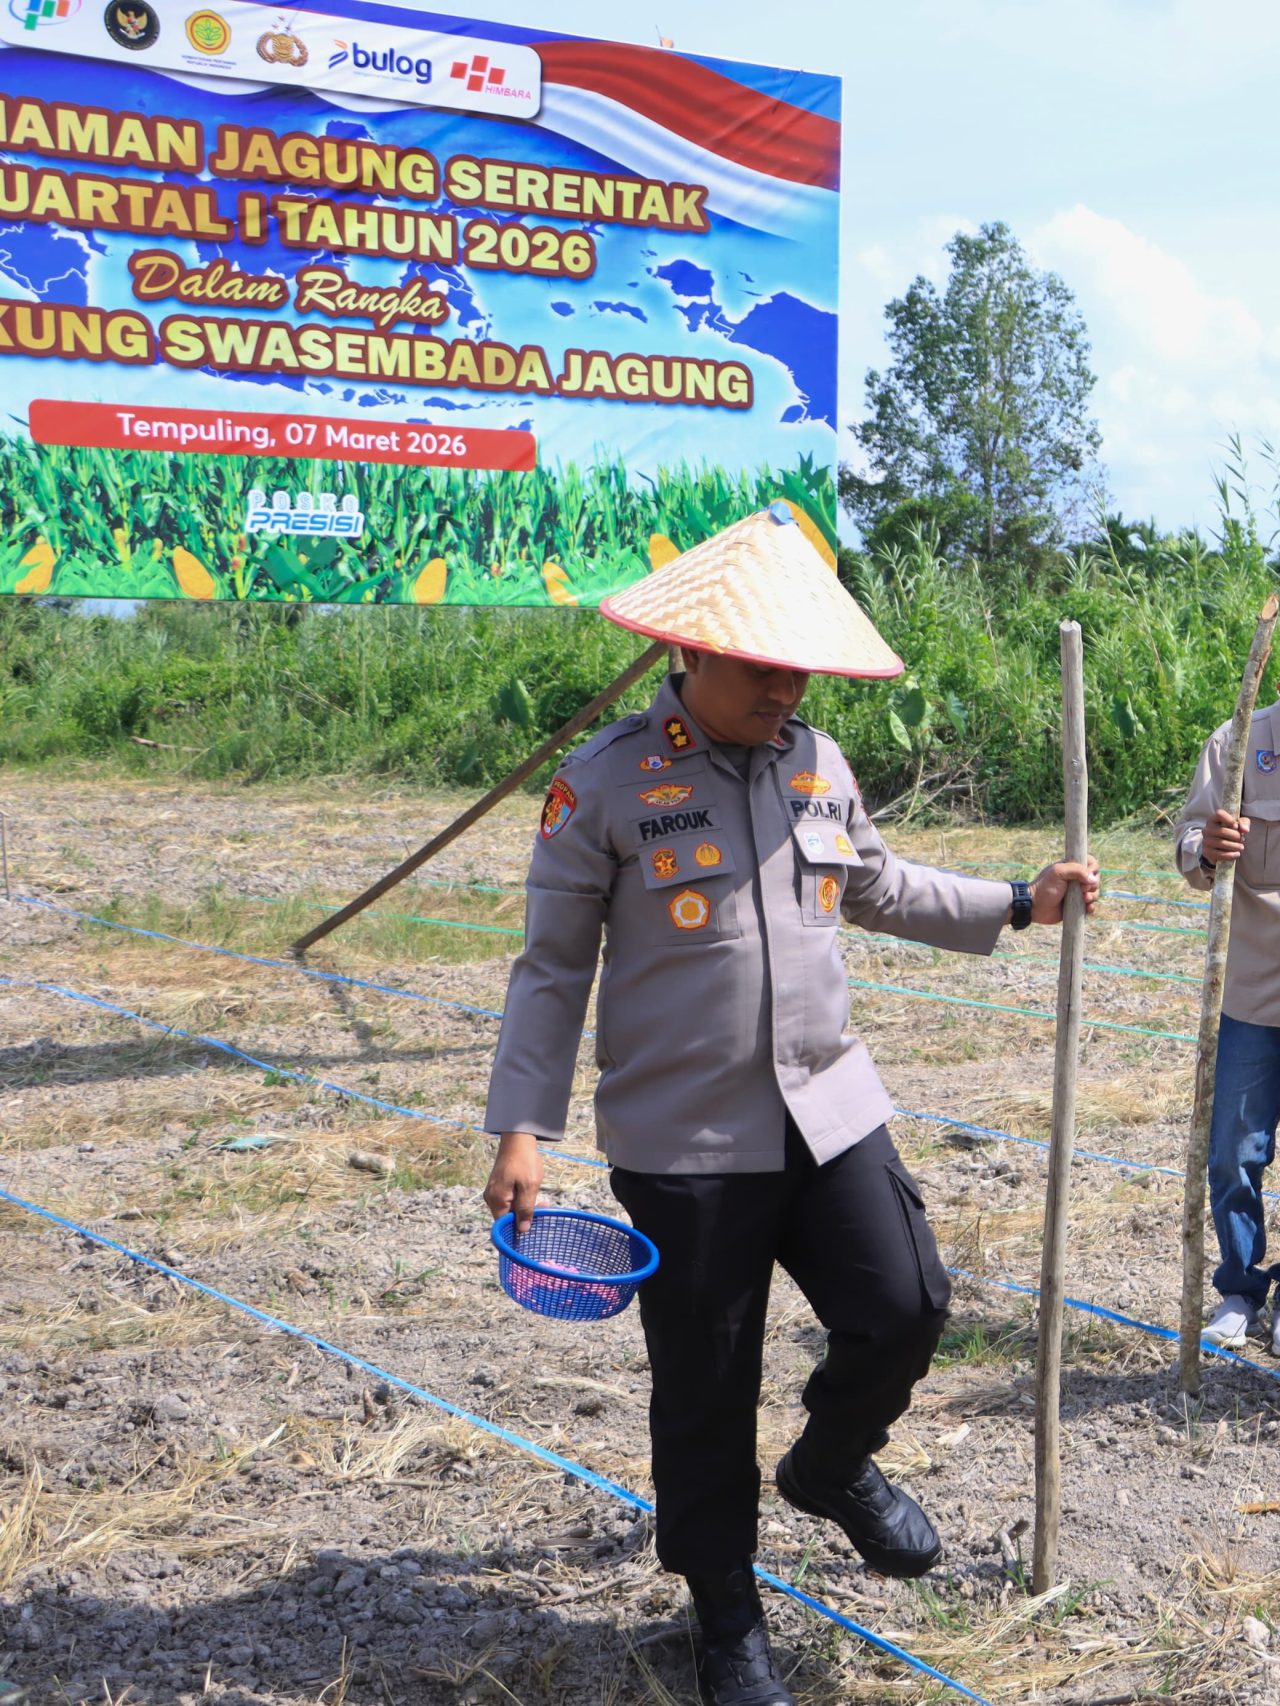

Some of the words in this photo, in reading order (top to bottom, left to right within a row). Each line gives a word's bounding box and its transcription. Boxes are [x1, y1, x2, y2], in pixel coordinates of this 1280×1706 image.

[352, 42, 433, 84] bulog
[485, 85, 532, 100] HIMBARA
[0, 98, 197, 167] AMAN
[215, 130, 435, 196] JAGUNG
[447, 160, 706, 227] SERENTAK
[244, 197, 263, 238] I
[277, 200, 454, 258] TAHUN
[467, 224, 592, 274] 2026
[132, 254, 285, 305] Dalam
[300, 270, 445, 327] Rangka
[164, 318, 551, 389] SWASEMBADA
[561, 353, 749, 403] JAGUNG
[116, 412, 277, 448] Tempuling,
[285, 423, 317, 446] 07
[326, 424, 400, 451] Maret
[407, 431, 467, 456] 2026
[249, 511, 361, 533] PRESISI
[639, 809, 714, 841] FAROUK
[790, 800, 842, 821] POLRI
